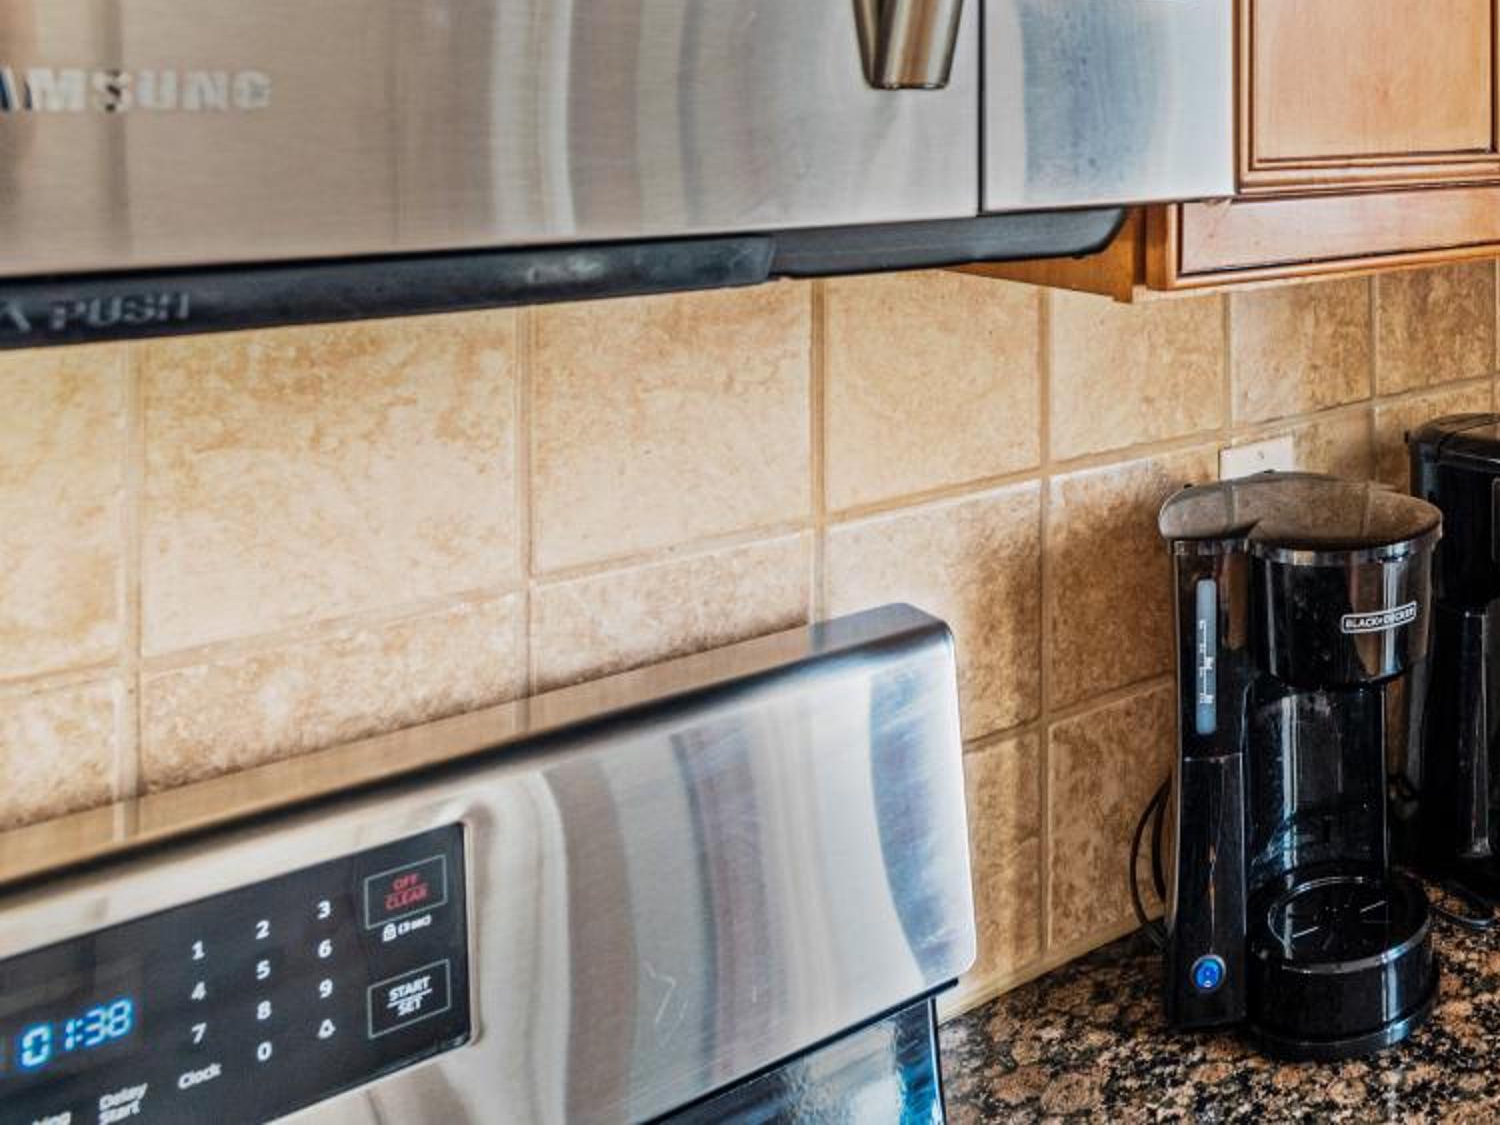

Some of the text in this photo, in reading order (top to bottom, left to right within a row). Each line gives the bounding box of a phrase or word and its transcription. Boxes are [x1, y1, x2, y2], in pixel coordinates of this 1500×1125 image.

[51, 293, 191, 330] PUSH
[318, 900, 332, 920] 3
[256, 920, 270, 939] 2
[193, 940, 205, 960] 1
[318, 939, 332, 958] 6
[256, 960, 270, 980] 5
[191, 981, 207, 1001] 4
[318, 979, 333, 999] 9
[388, 976, 432, 1002] START
[257, 1000, 271, 1020] 8
[191, 1022, 207, 1044] 7
[257, 1041, 272, 1062] 0
[178, 1063, 222, 1090] Clock
